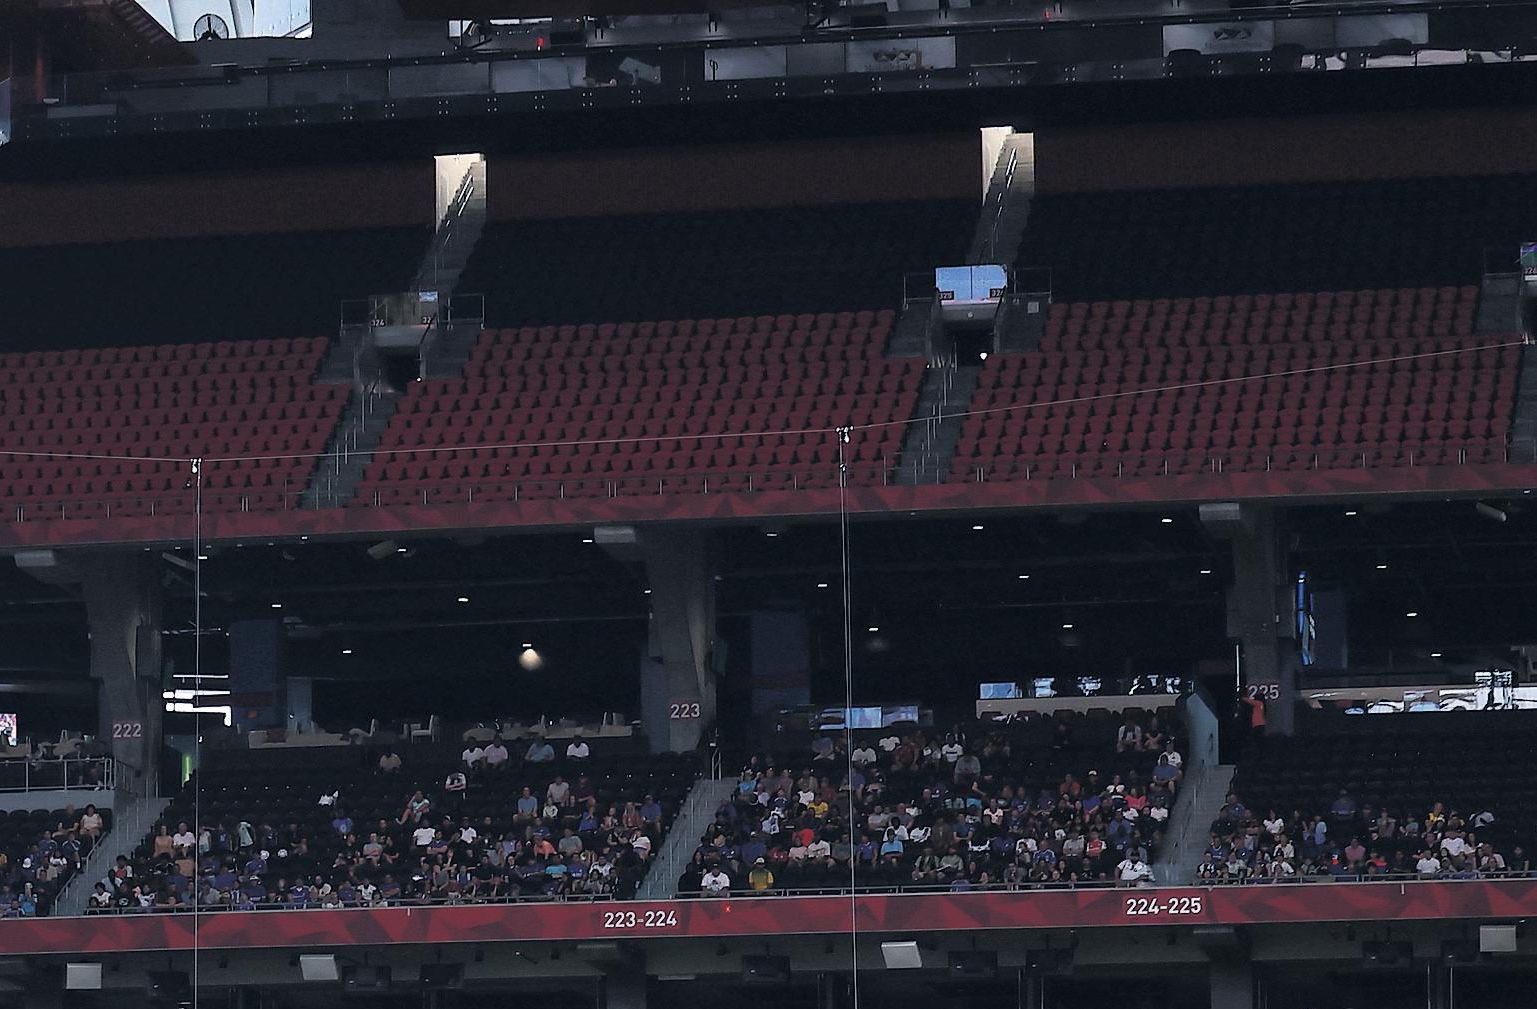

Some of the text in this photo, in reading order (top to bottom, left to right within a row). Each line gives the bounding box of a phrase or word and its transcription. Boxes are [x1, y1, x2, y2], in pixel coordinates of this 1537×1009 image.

[670, 703, 700, 719] 223
[113, 723, 142, 738] 222
[1126, 897, 1202, 915] 224-225
[604, 910, 677, 928] 223-224
